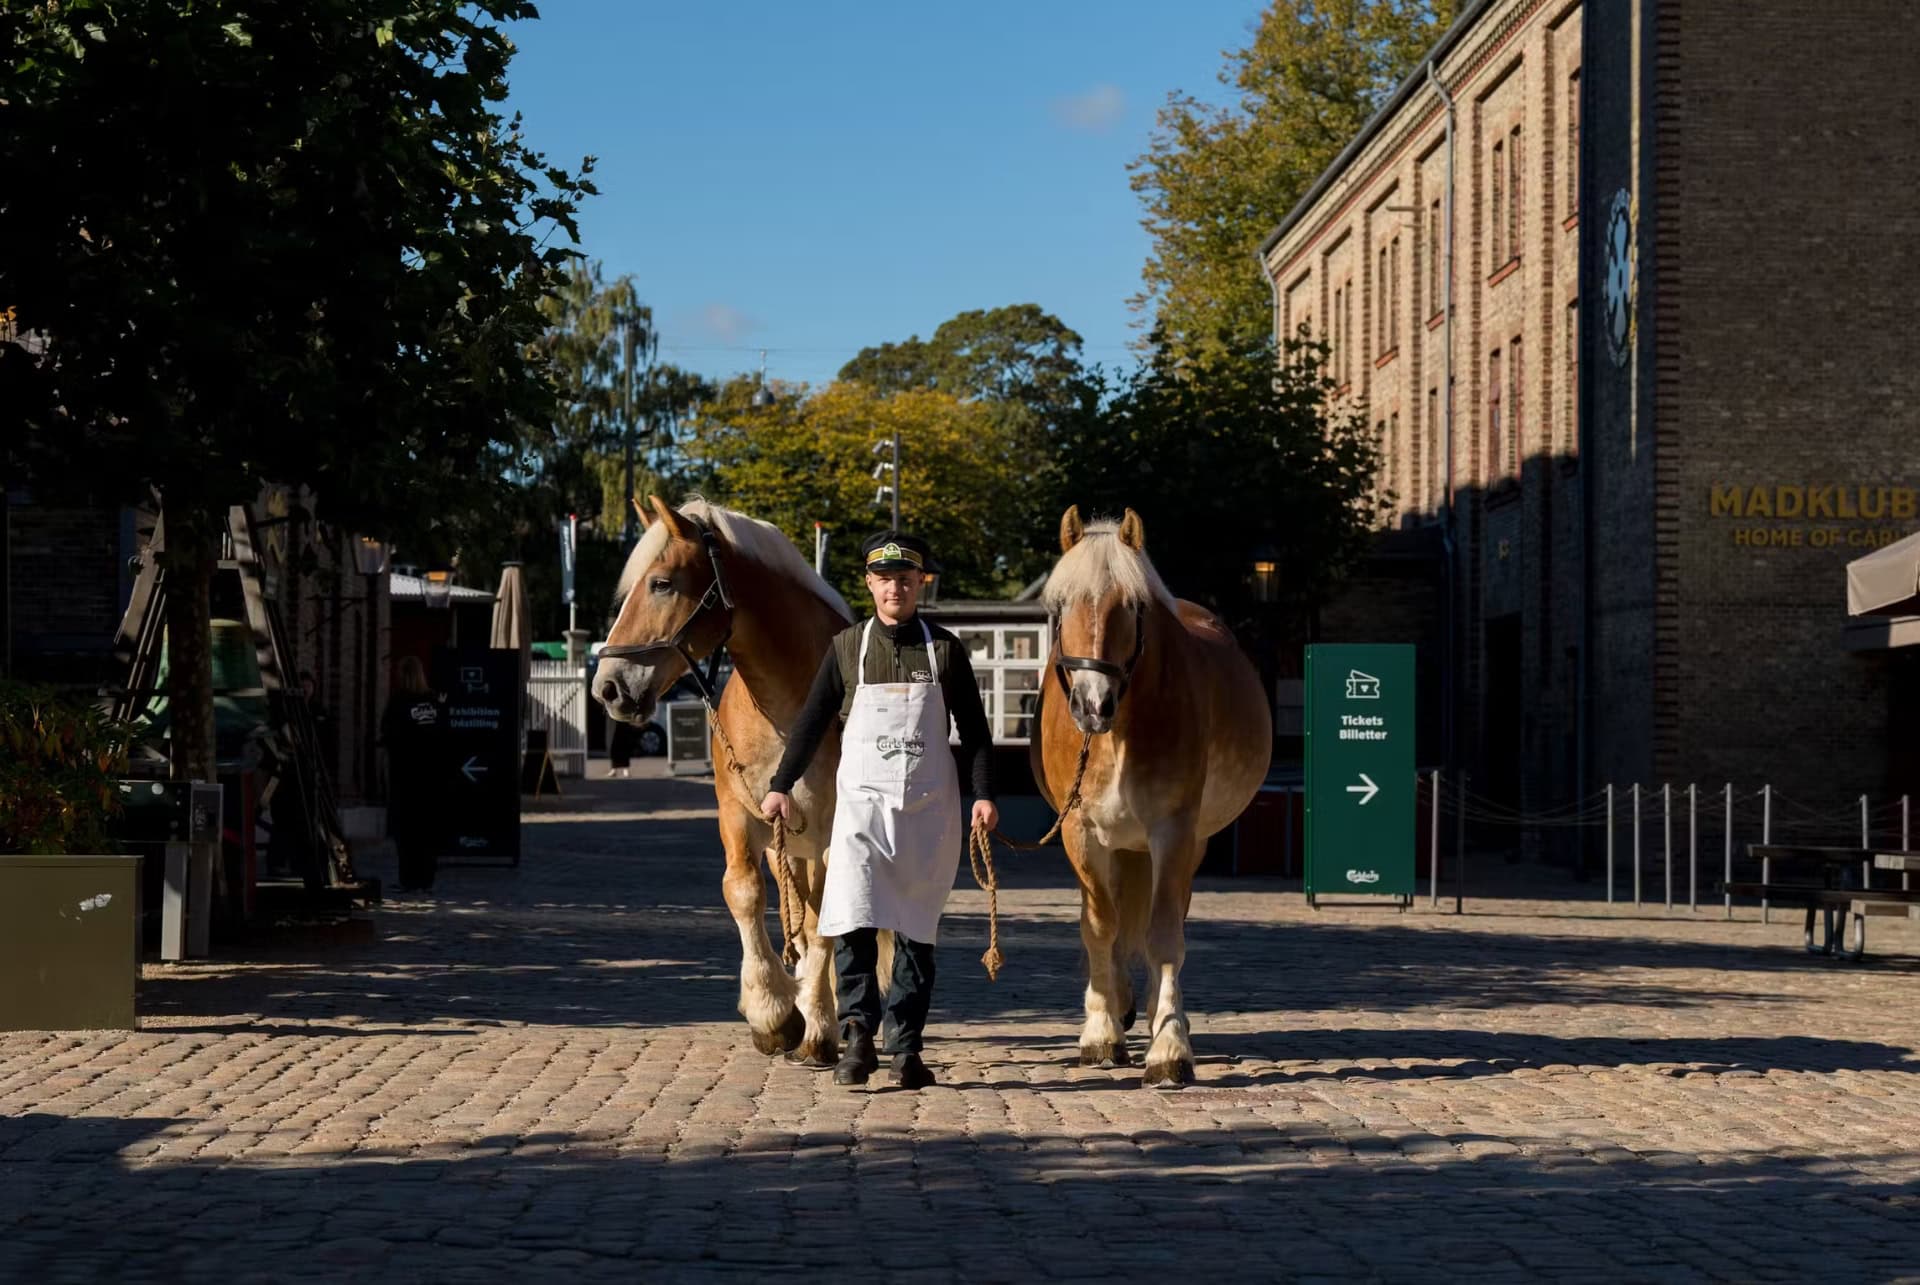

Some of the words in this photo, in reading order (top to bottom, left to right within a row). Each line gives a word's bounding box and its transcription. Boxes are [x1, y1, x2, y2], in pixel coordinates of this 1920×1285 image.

[1711, 484, 1917, 519] MADKLUB
[1735, 529, 1804, 546] HOME
[1810, 529, 1841, 546] OF
[449, 707, 500, 717] Exhibition
[1341, 715, 1384, 727] Tickets
[1339, 729, 1388, 740] Billetter
[876, 734, 925, 756] Carlsberg
